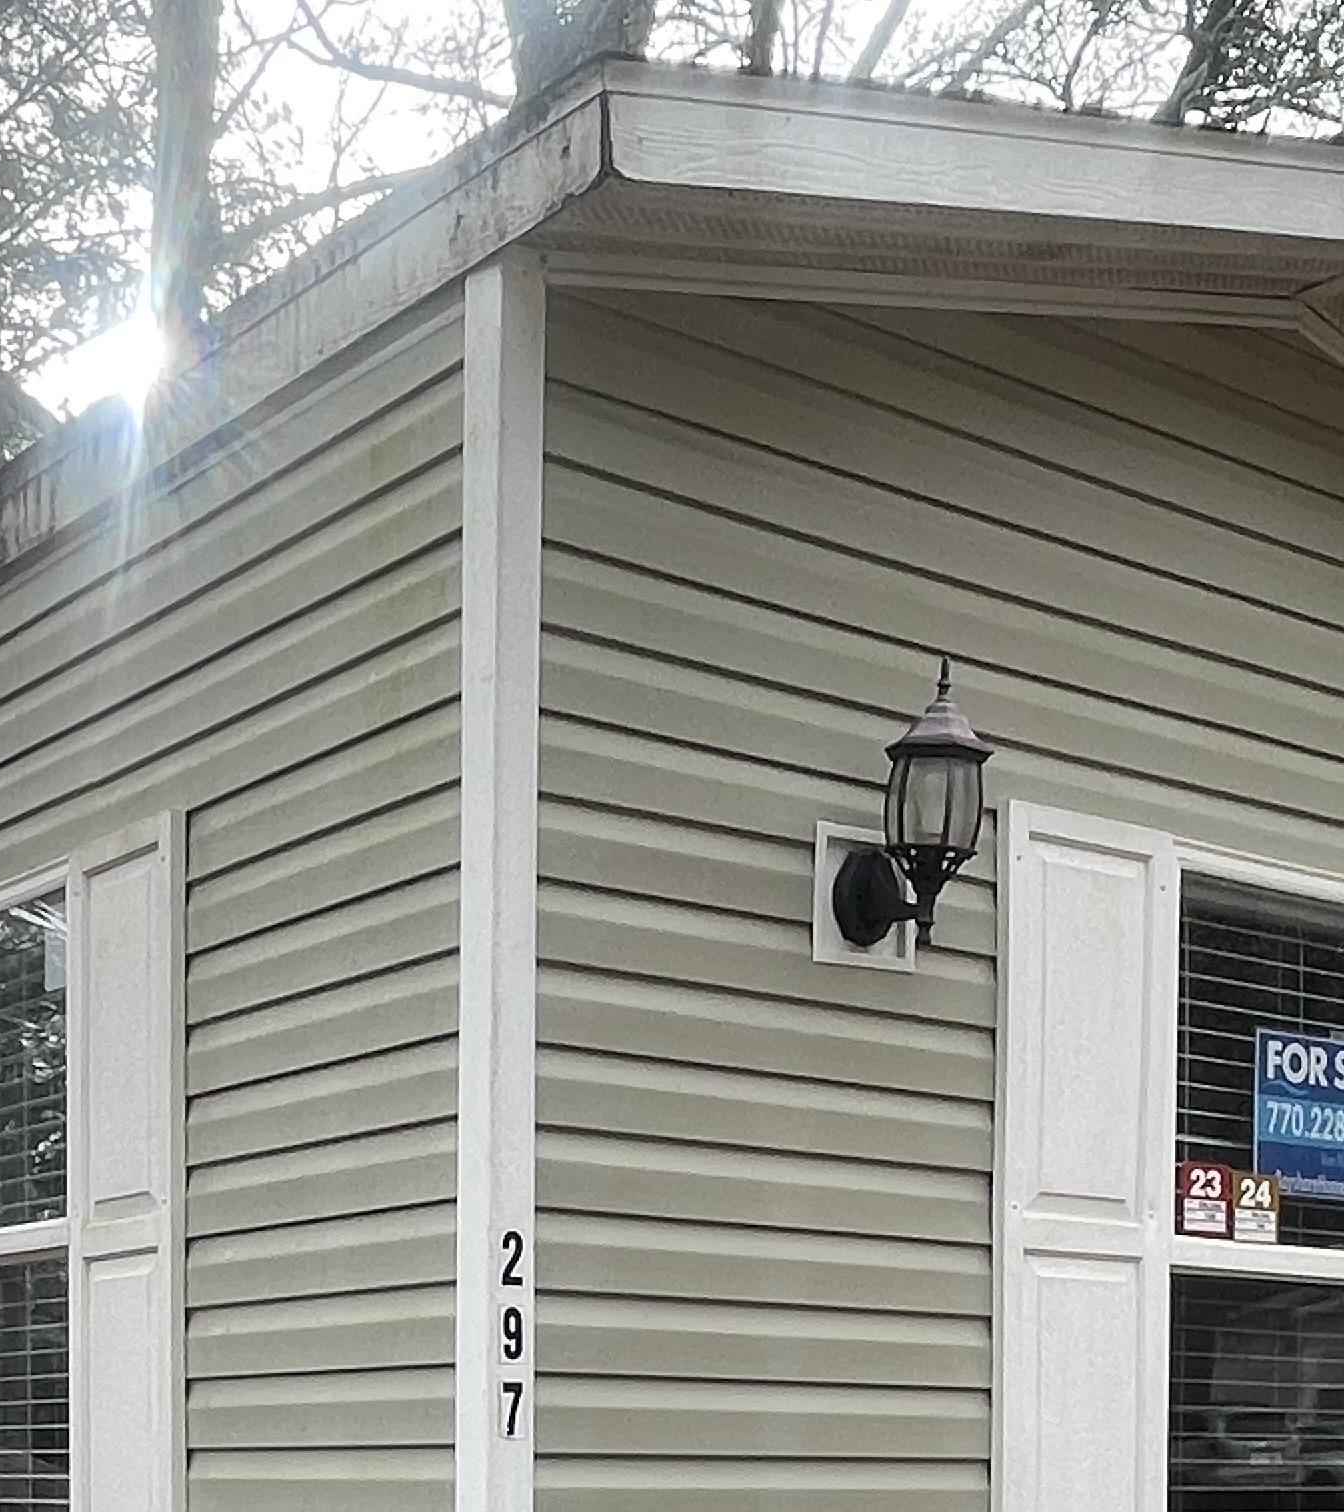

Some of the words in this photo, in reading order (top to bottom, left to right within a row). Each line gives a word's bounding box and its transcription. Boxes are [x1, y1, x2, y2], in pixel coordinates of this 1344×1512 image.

[1266, 1040, 1328, 1088] FOR
[1189, 1168, 1223, 1198] 23
[1239, 1178, 1271, 1208] 24
[502, 1231, 523, 1436] 297
